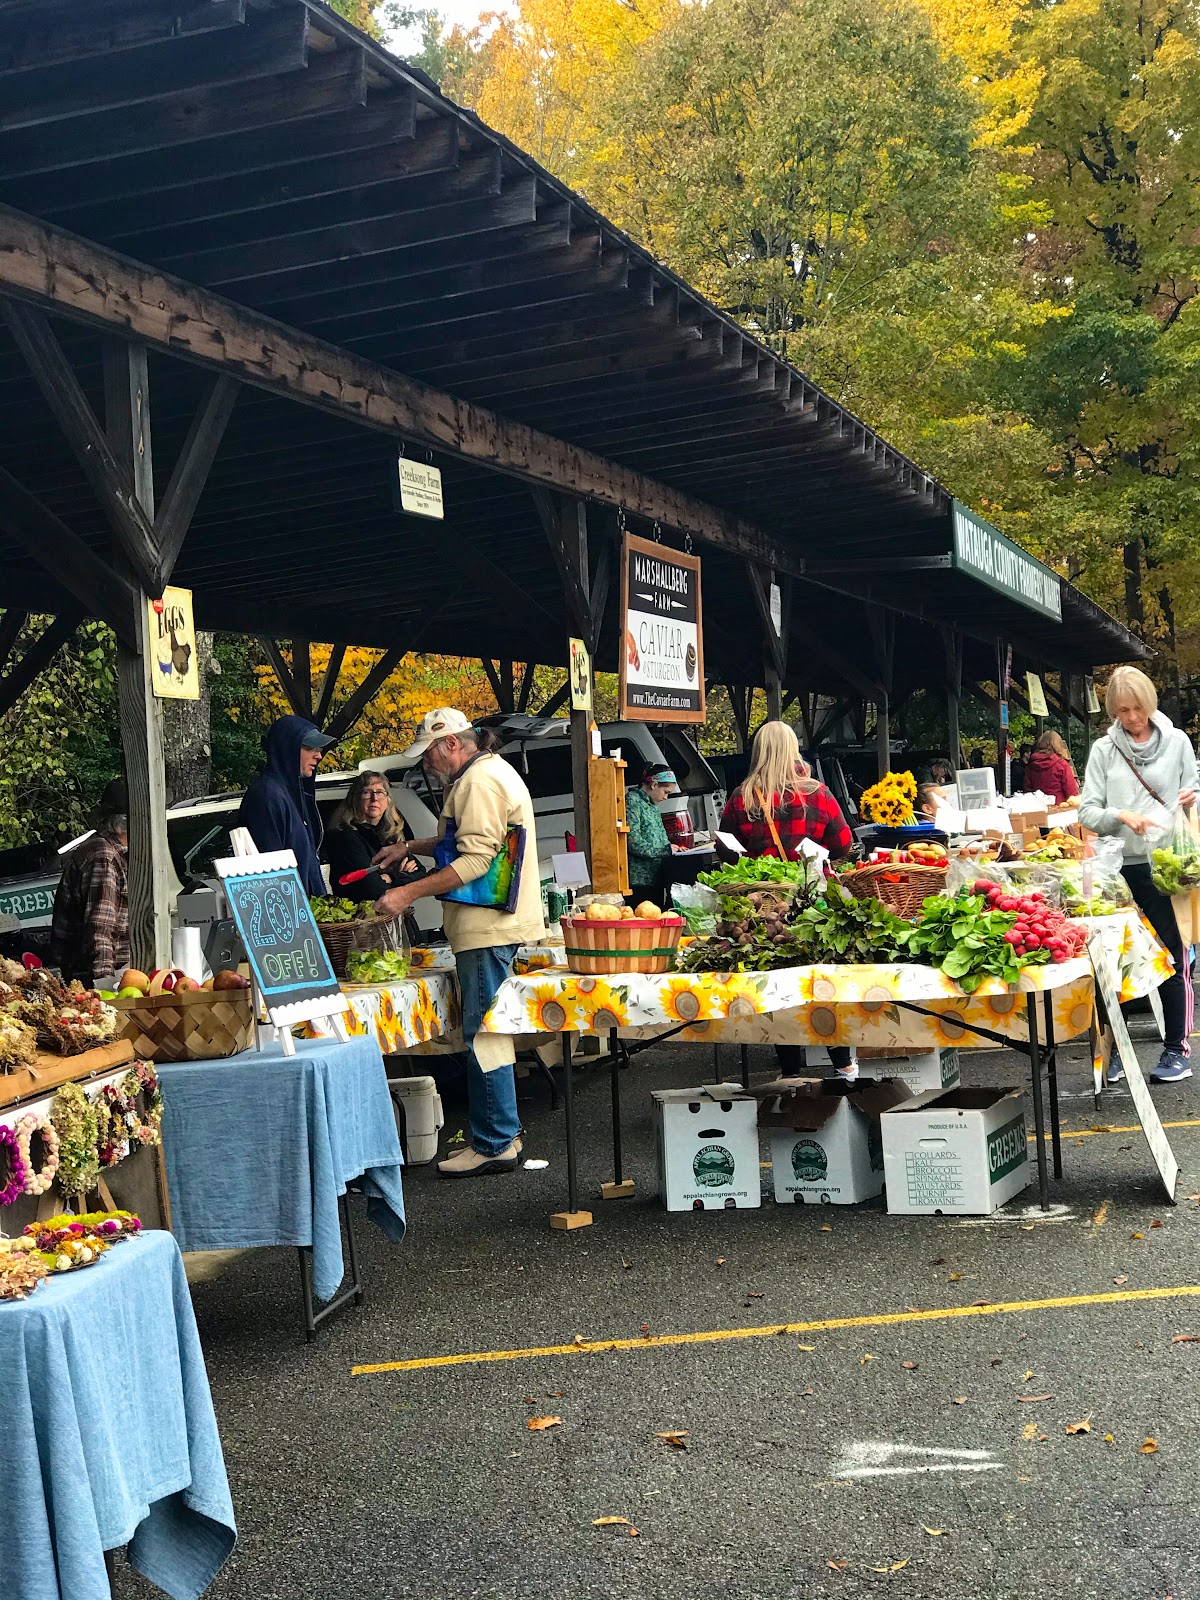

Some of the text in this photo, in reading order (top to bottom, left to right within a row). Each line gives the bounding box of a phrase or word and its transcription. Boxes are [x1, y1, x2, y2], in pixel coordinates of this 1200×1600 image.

[400, 464, 440, 489] Creeksong Farm
[956, 511, 994, 577] WATAUGA
[994, 540, 1019, 592] COUNTY
[635, 555, 688, 594] MARSHALLBERG
[654, 591, 671, 611] FARM
[157, 606, 185, 639] EGGS
[640, 621, 684, 659] CAVIAR
[646, 661, 680, 681] STURGEON
[632, 691, 691, 708] www.TheCaviarFarm.com
[240, 880, 308, 947] 20%
[264, 938, 319, 981] OFF!
[914, 1151, 957, 1159] COLLARDS
[988, 1123, 1027, 1173] GREENS
[915, 1159, 934, 1167] KALE
[916, 1174, 952, 1182] SPINACH
[917, 1181, 962, 1189] MUSTARDS
[682, 1191, 748, 1200] appalachiangrown.org
